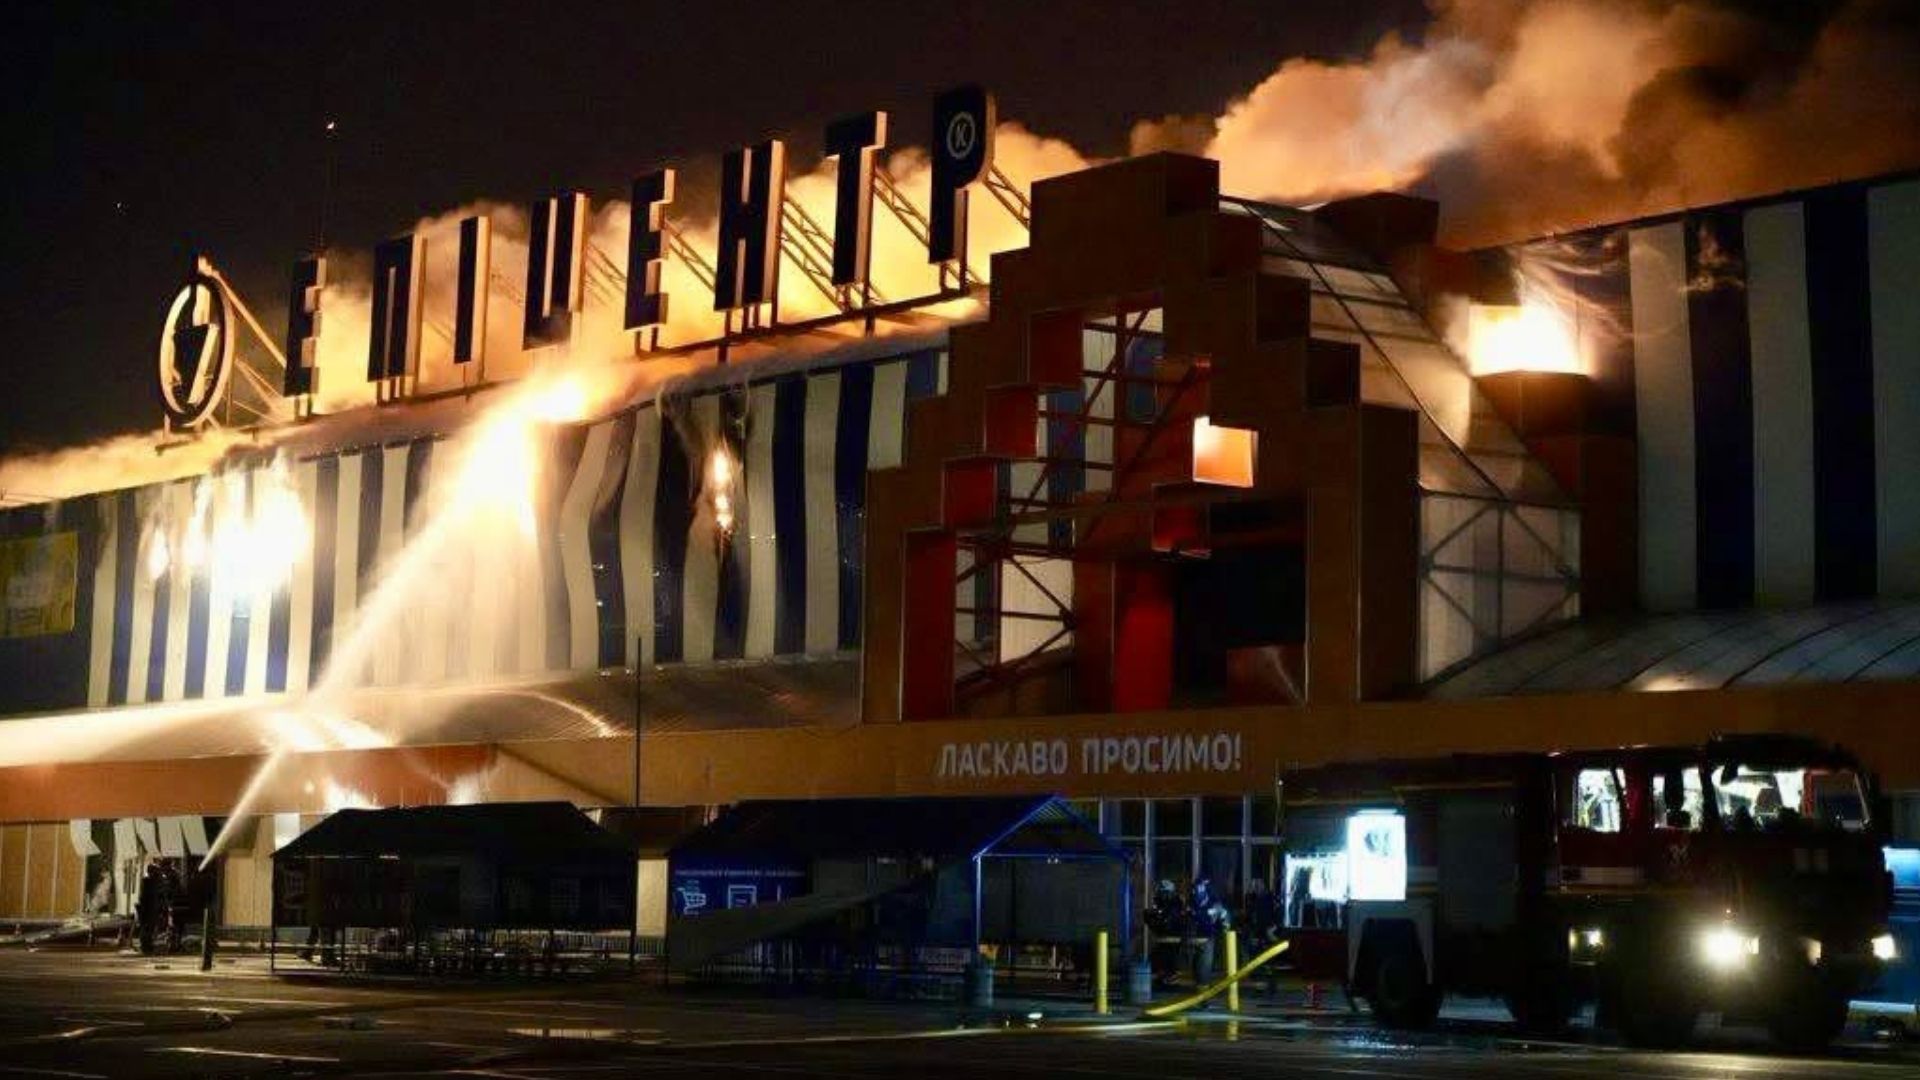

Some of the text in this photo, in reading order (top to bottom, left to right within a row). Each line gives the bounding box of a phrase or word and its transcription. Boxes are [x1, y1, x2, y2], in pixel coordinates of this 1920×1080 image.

[284, 86, 997, 397] ЕПІЦЕНТР
[938, 733, 1242, 776] ЛАСКАВО ПРОСИМО!
